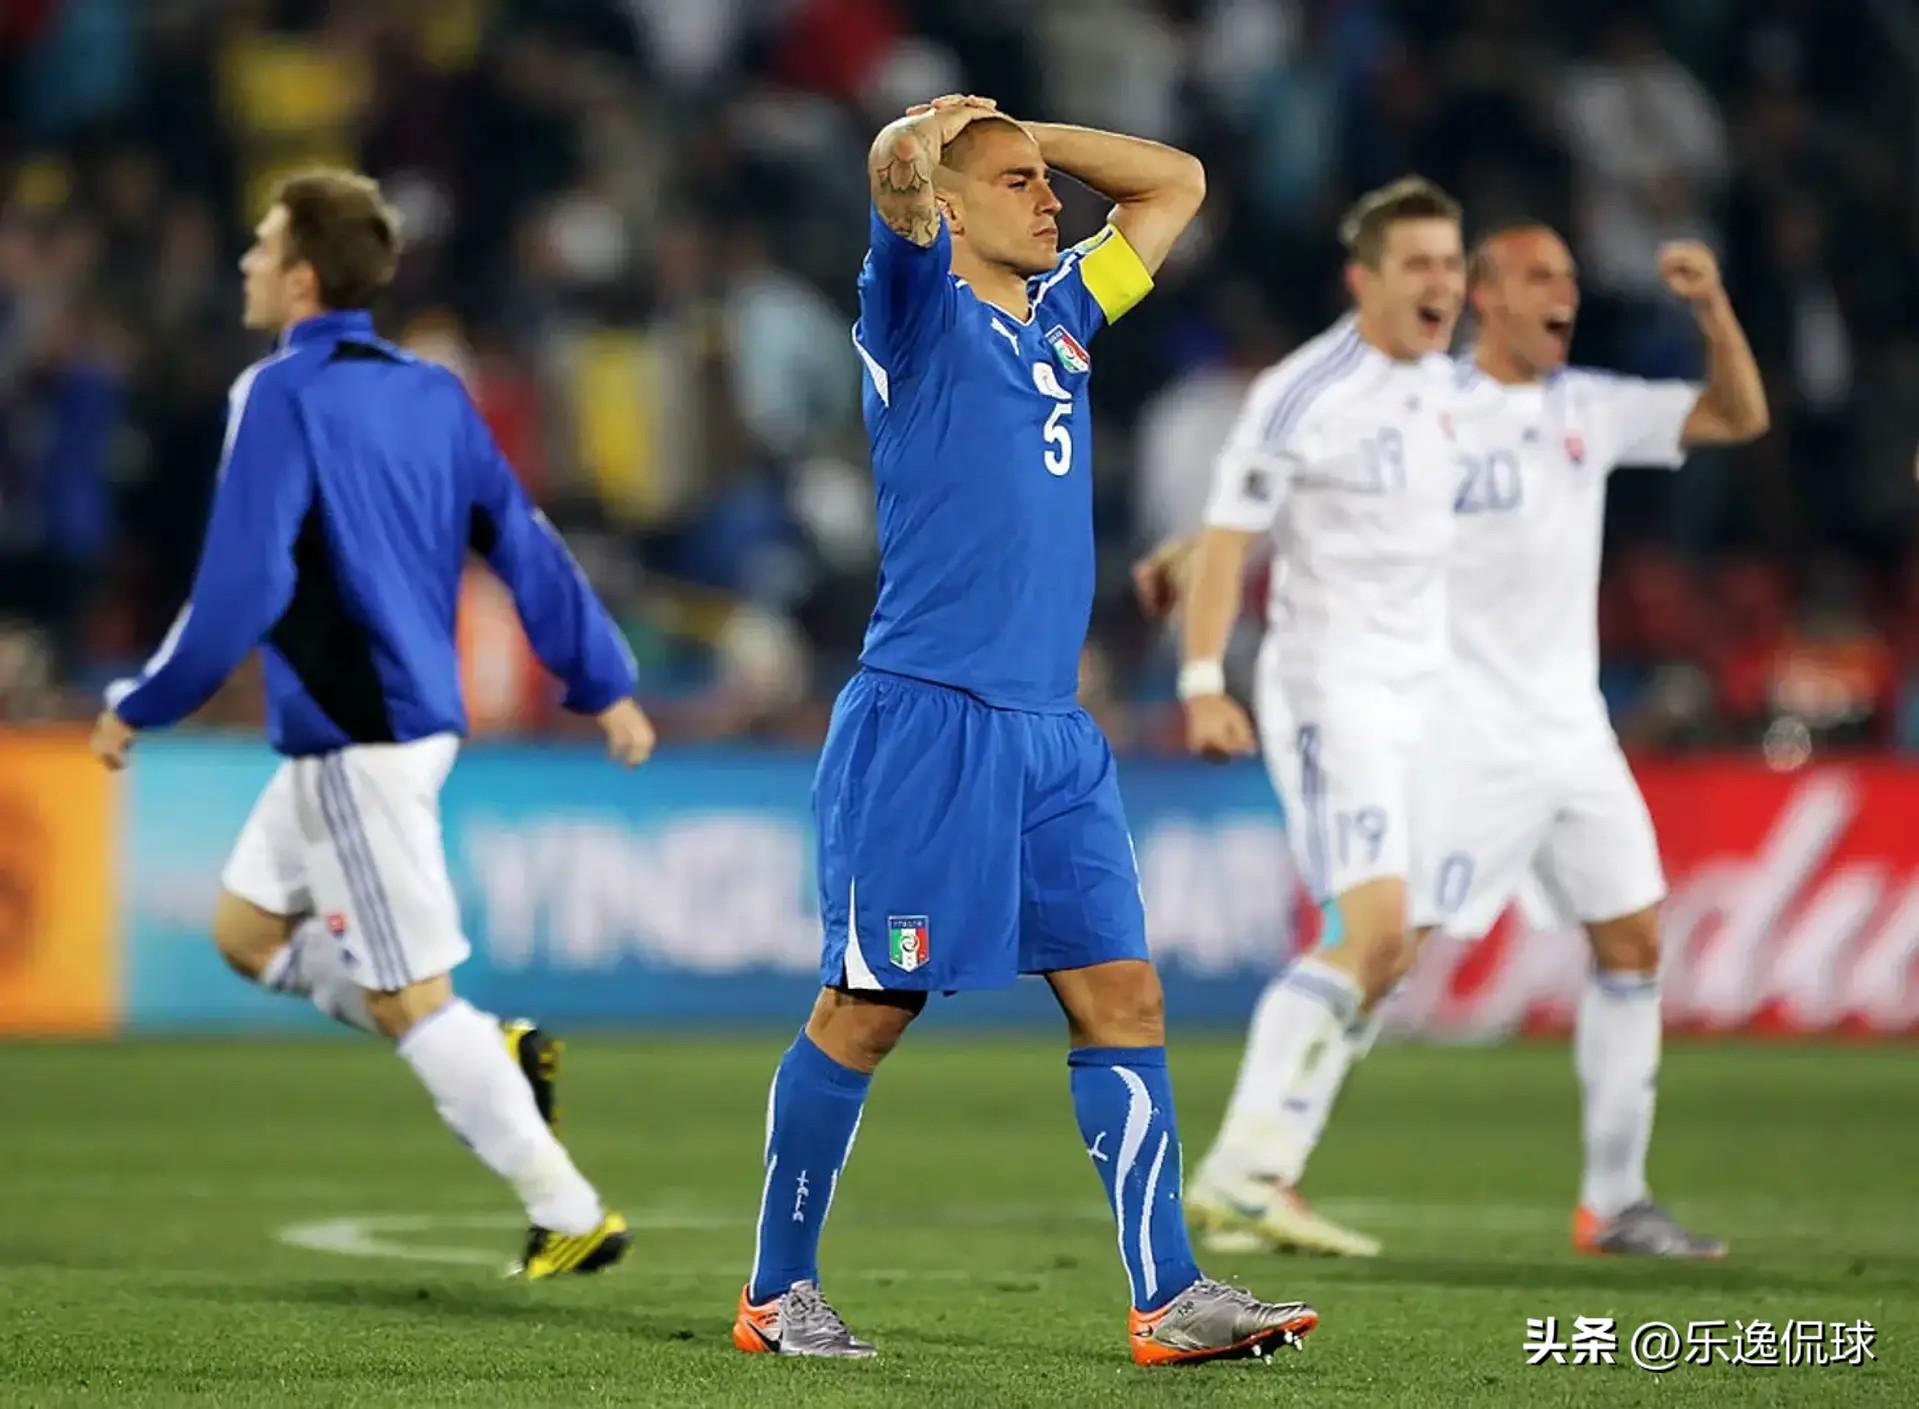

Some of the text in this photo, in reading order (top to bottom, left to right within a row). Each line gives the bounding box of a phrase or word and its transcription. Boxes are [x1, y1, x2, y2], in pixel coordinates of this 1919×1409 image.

[1043, 402, 1073, 476] 5
[1452, 450, 1522, 513] 20
[1335, 805, 1387, 868] 19
